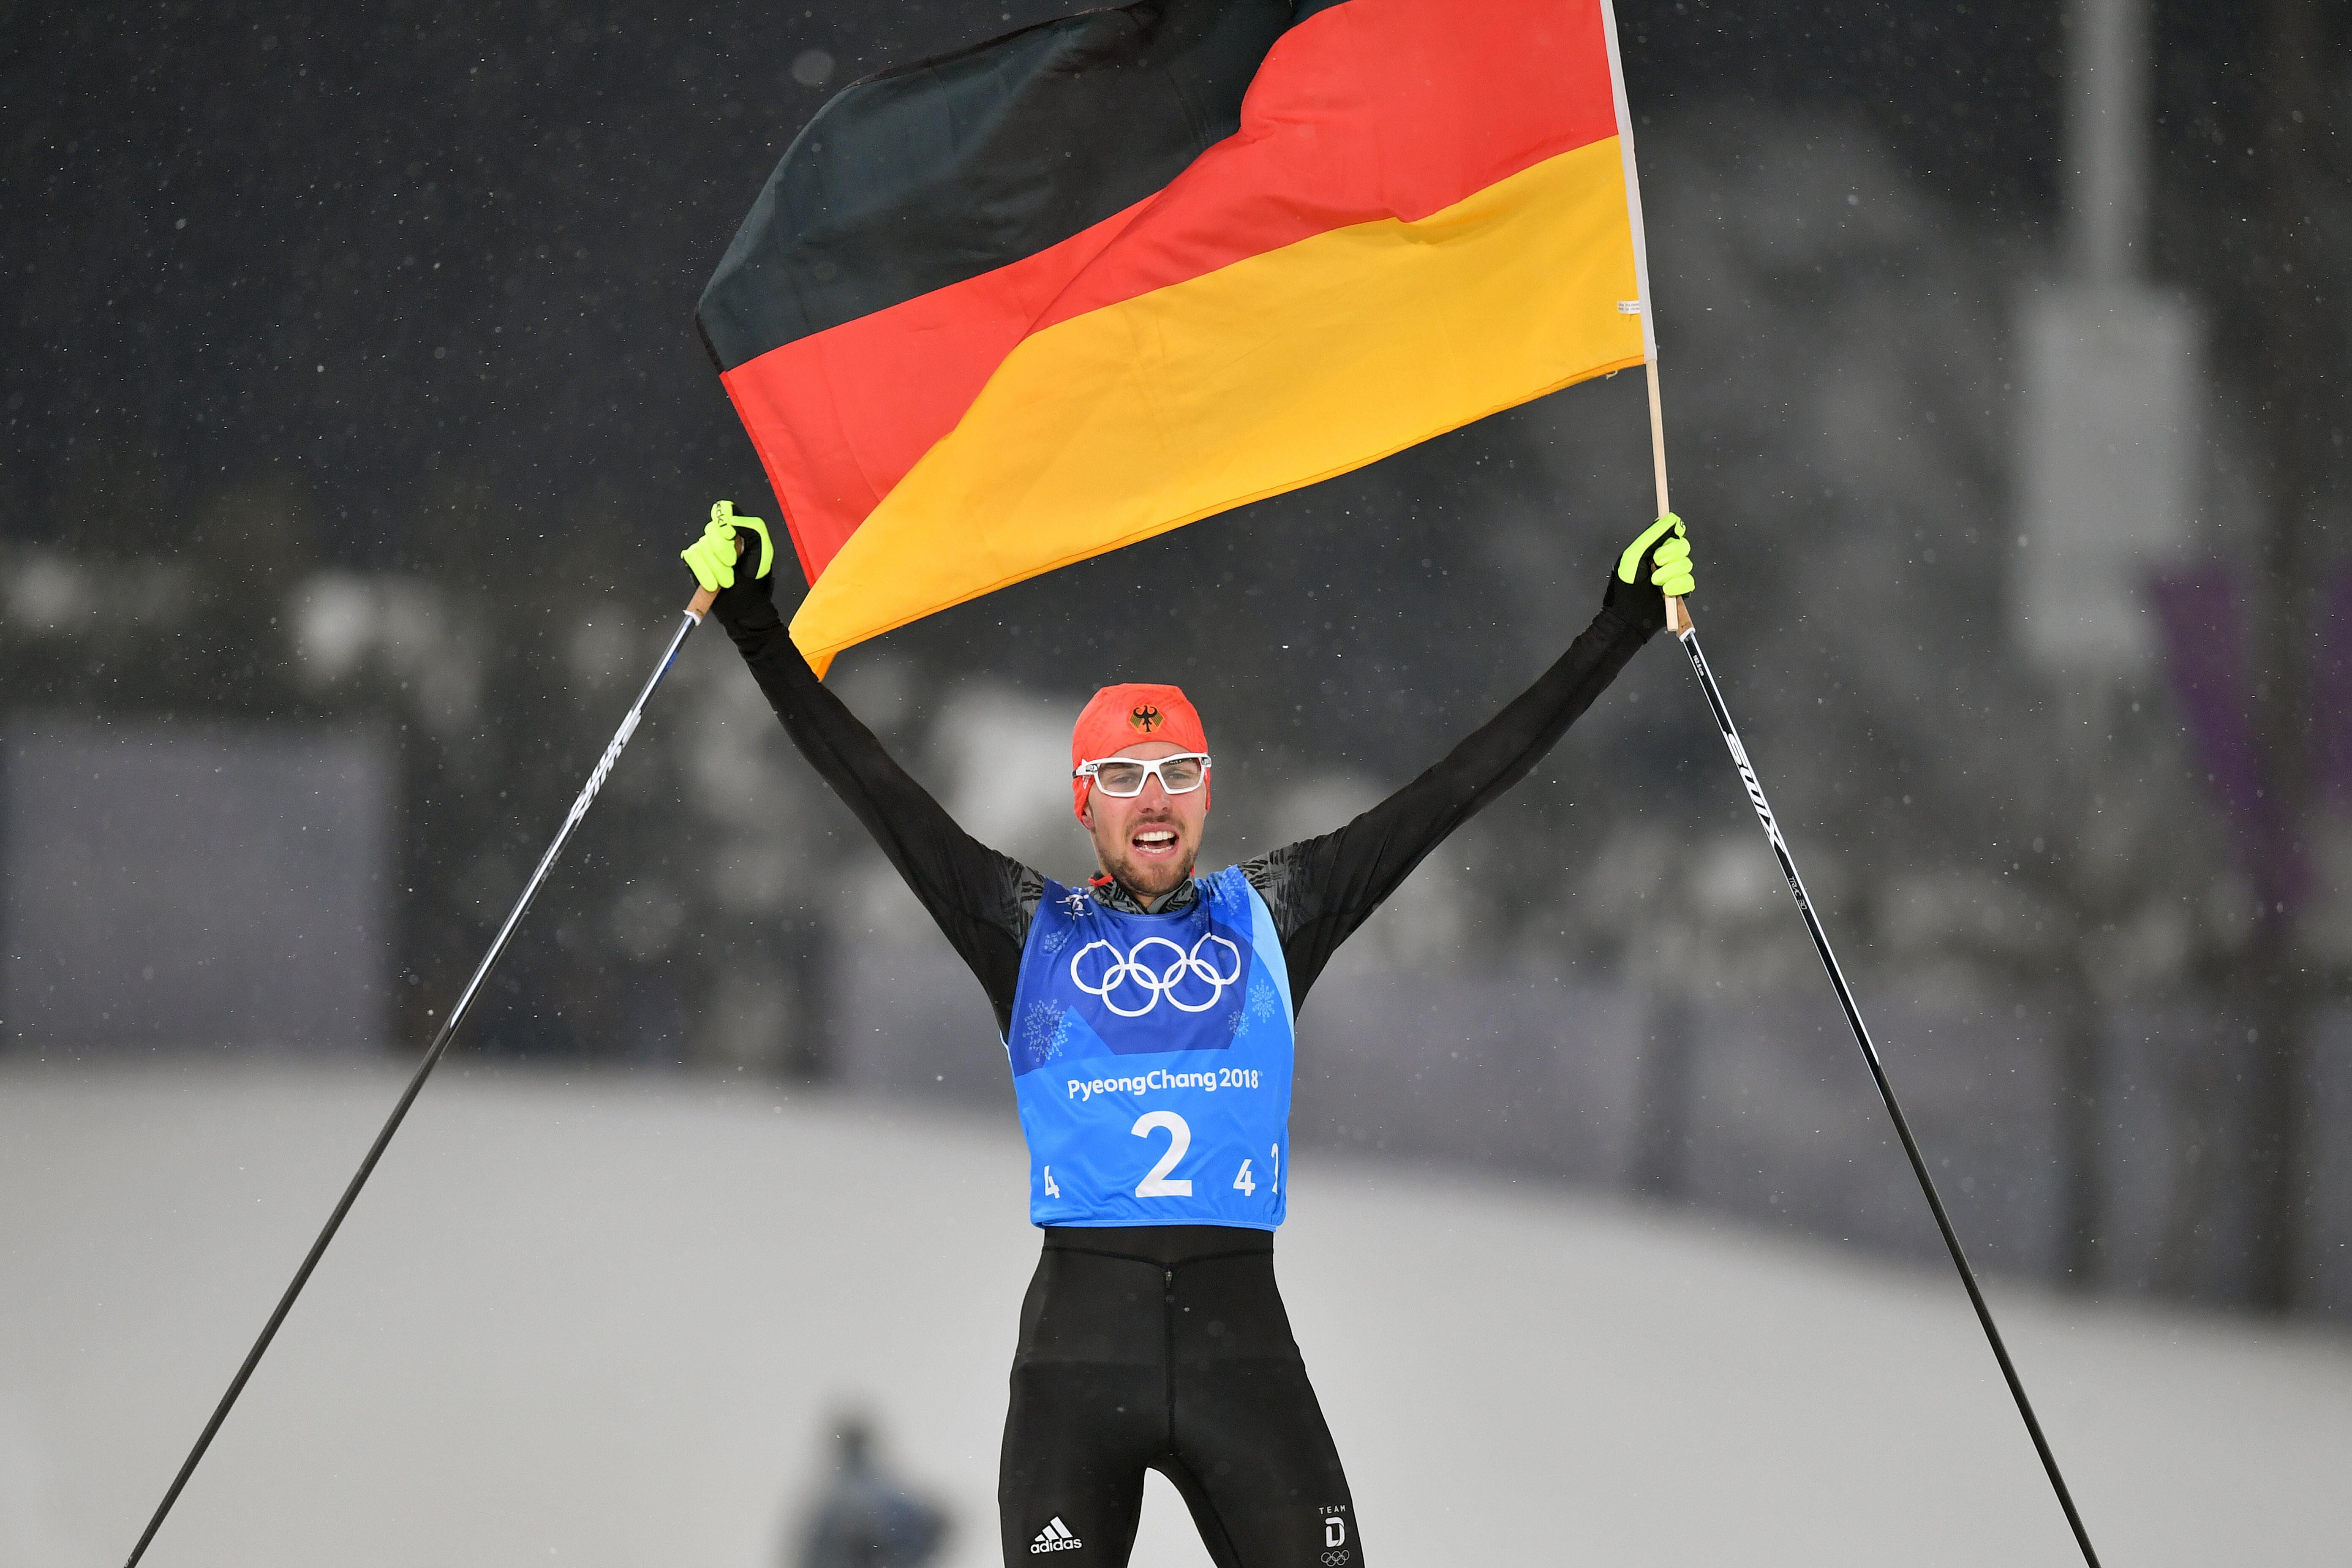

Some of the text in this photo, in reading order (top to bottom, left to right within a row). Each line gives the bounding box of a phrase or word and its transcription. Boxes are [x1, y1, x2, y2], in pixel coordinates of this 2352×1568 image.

[1067, 1067, 1259, 1102] PyeongChang 2018
[1130, 1110, 1193, 1198] 2
[1043, 1165, 1060, 1199] 4
[1233, 1158, 1256, 1197] 4
[1318, 1504, 1346, 1515] TEAM
[1030, 1538, 1083, 1554] adidas
